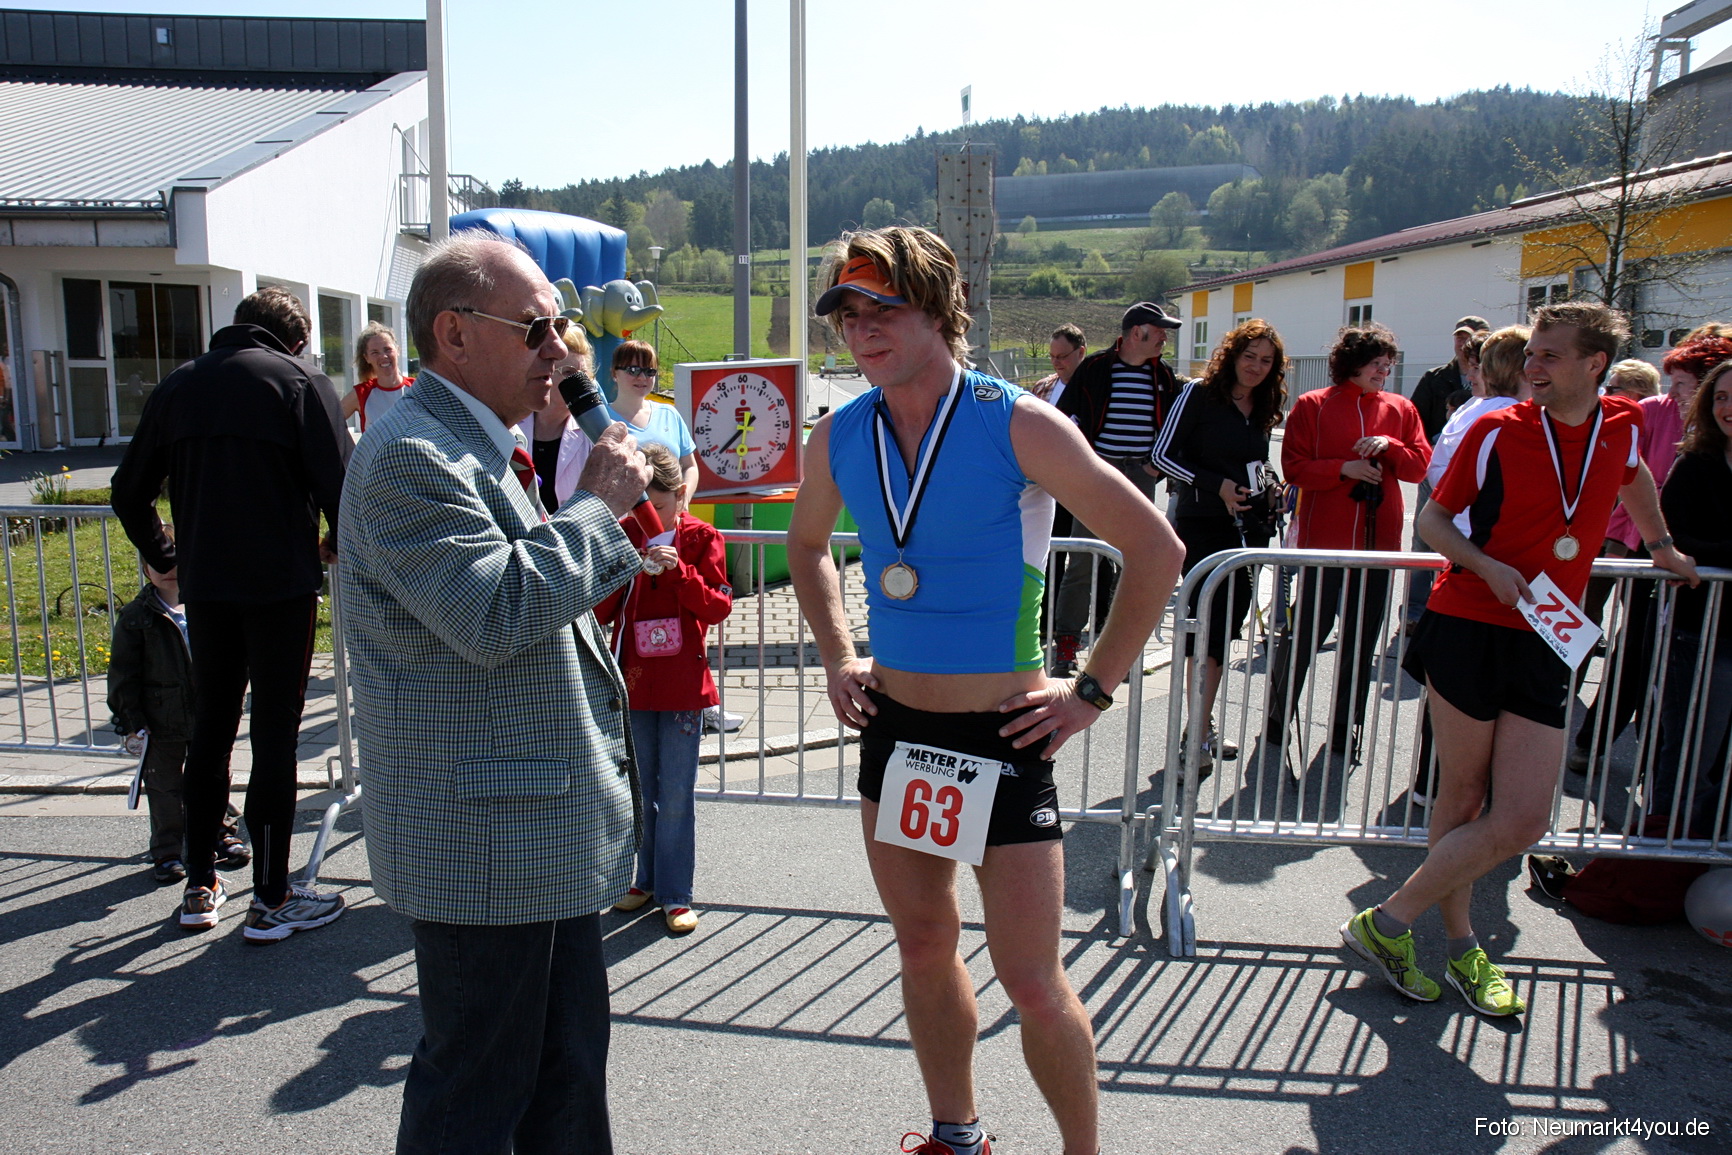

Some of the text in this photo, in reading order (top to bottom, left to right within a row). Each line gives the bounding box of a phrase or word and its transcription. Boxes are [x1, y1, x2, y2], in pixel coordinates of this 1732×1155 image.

[738, 375, 748, 383] 60
[717, 383, 726, 391] 55
[762, 381, 767, 389] 5
[700, 403, 710, 411] 50
[777, 399, 785, 407] 10
[782, 421, 789, 429] 15
[695, 427, 705, 435] 45
[777, 443, 786, 451] 20
[717, 467, 726, 475] 35
[761, 464, 770, 472] 25
[739, 472, 749, 480] 30
[1534, 592, 1584, 643] 22
[906, 748, 957, 768] MEYER
[905, 760, 955, 778] WERBUNG
[900, 778, 963, 847] 63
